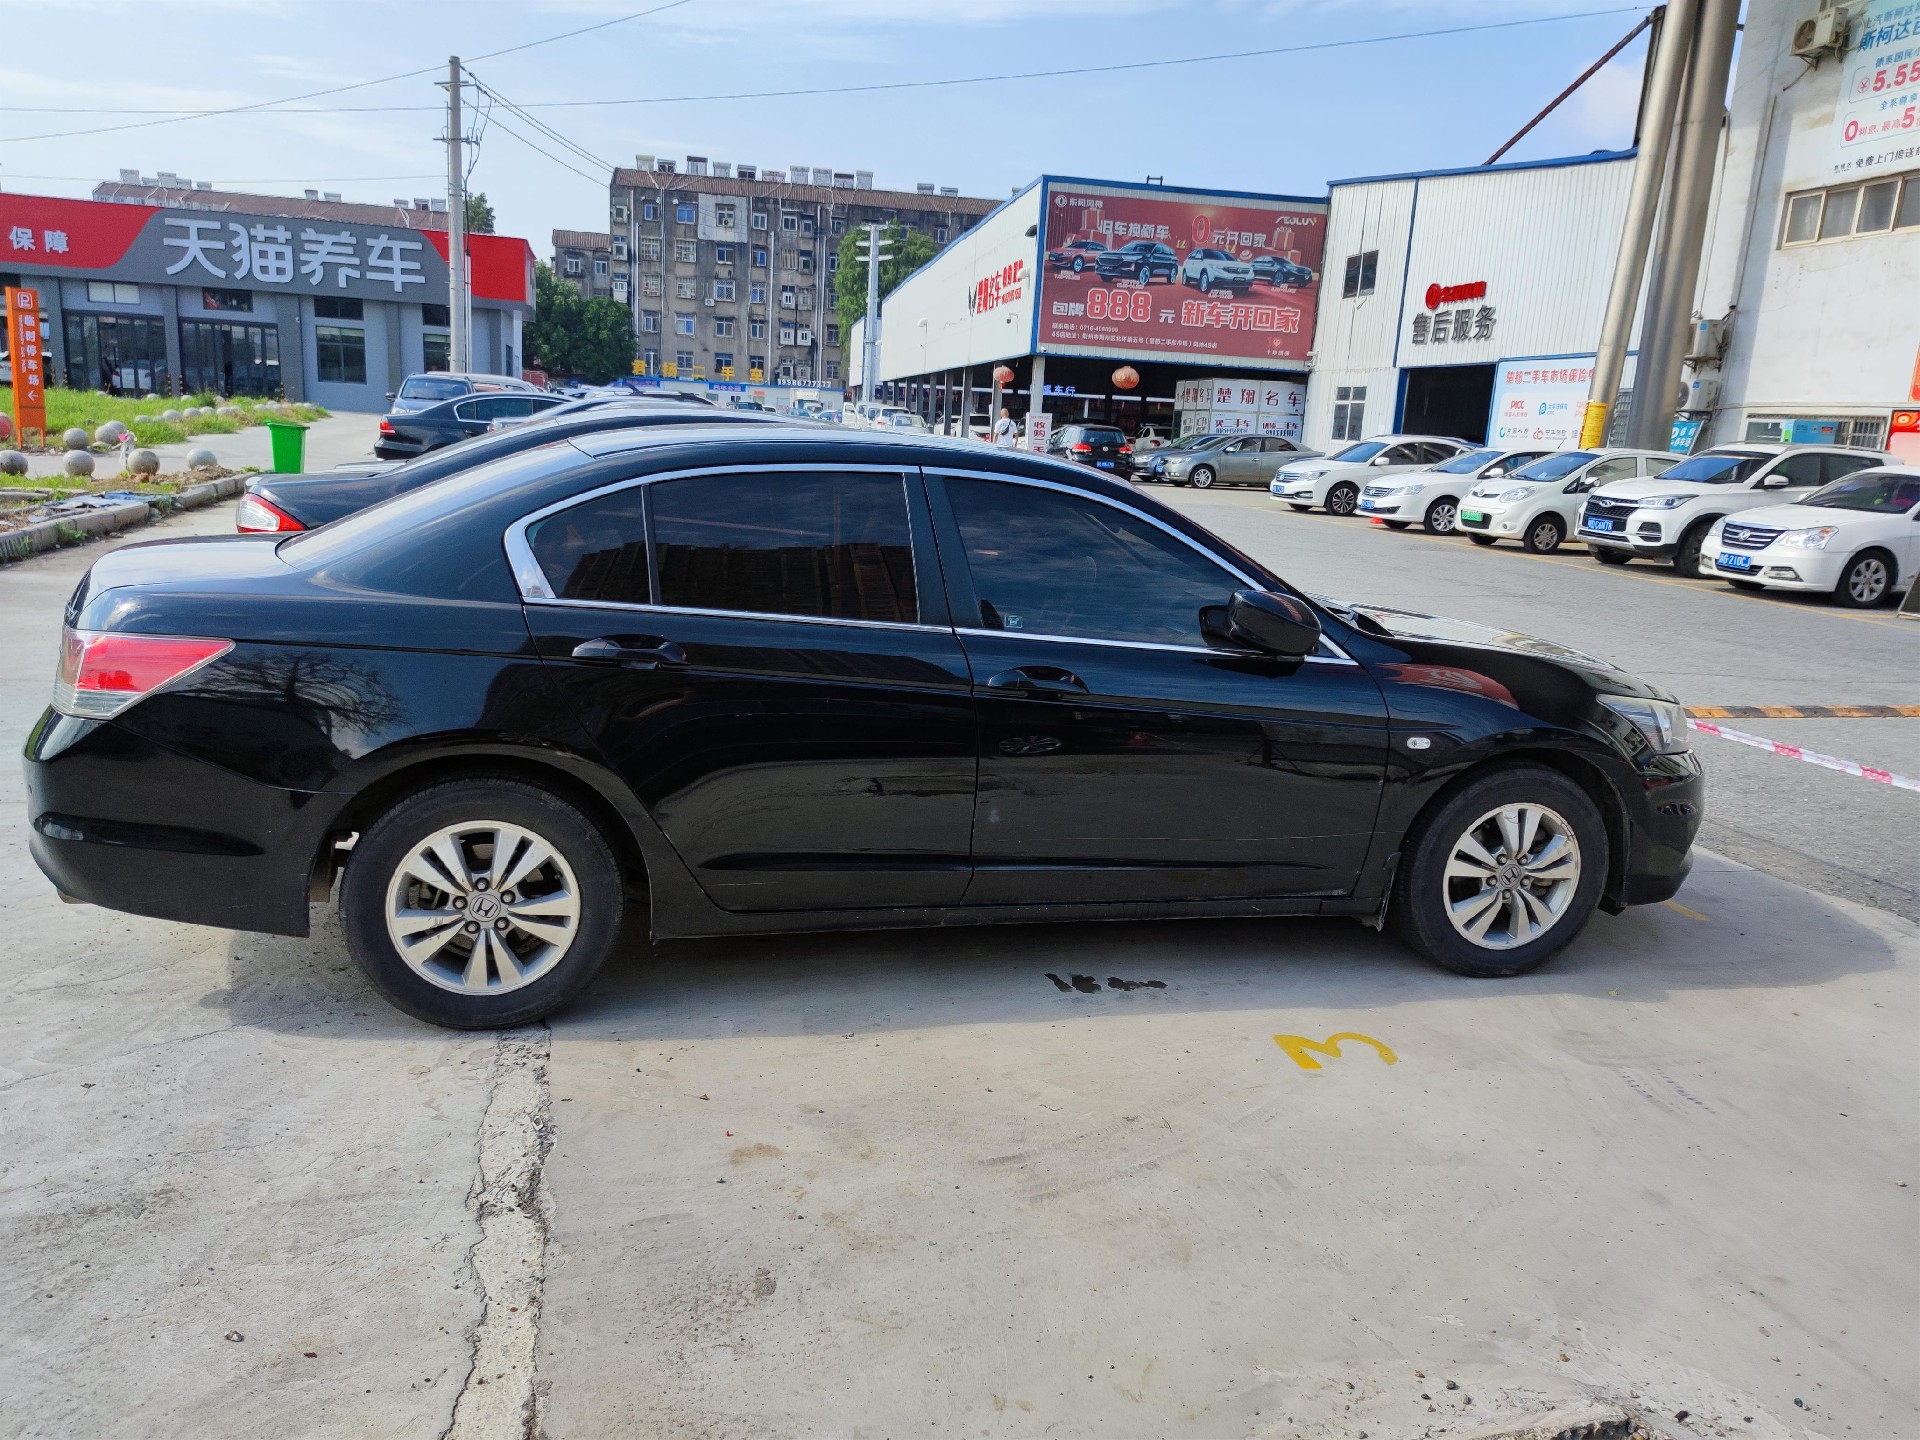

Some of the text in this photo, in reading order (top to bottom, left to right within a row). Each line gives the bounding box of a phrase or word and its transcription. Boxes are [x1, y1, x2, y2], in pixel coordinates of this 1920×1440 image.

[9, 226, 69, 253] 保障
[1099, 220, 1171, 239] 旧车换新车
[163, 217, 426, 292] 天猫养车
[1181, 300, 1300, 333] 新车开回家
[1412, 304, 1496, 345] 售后服务
[25, 315, 40, 386] 临时停车场
[1217, 387, 1302, 407] 楚翔名车
[1510, 401, 1525, 409] PICC
